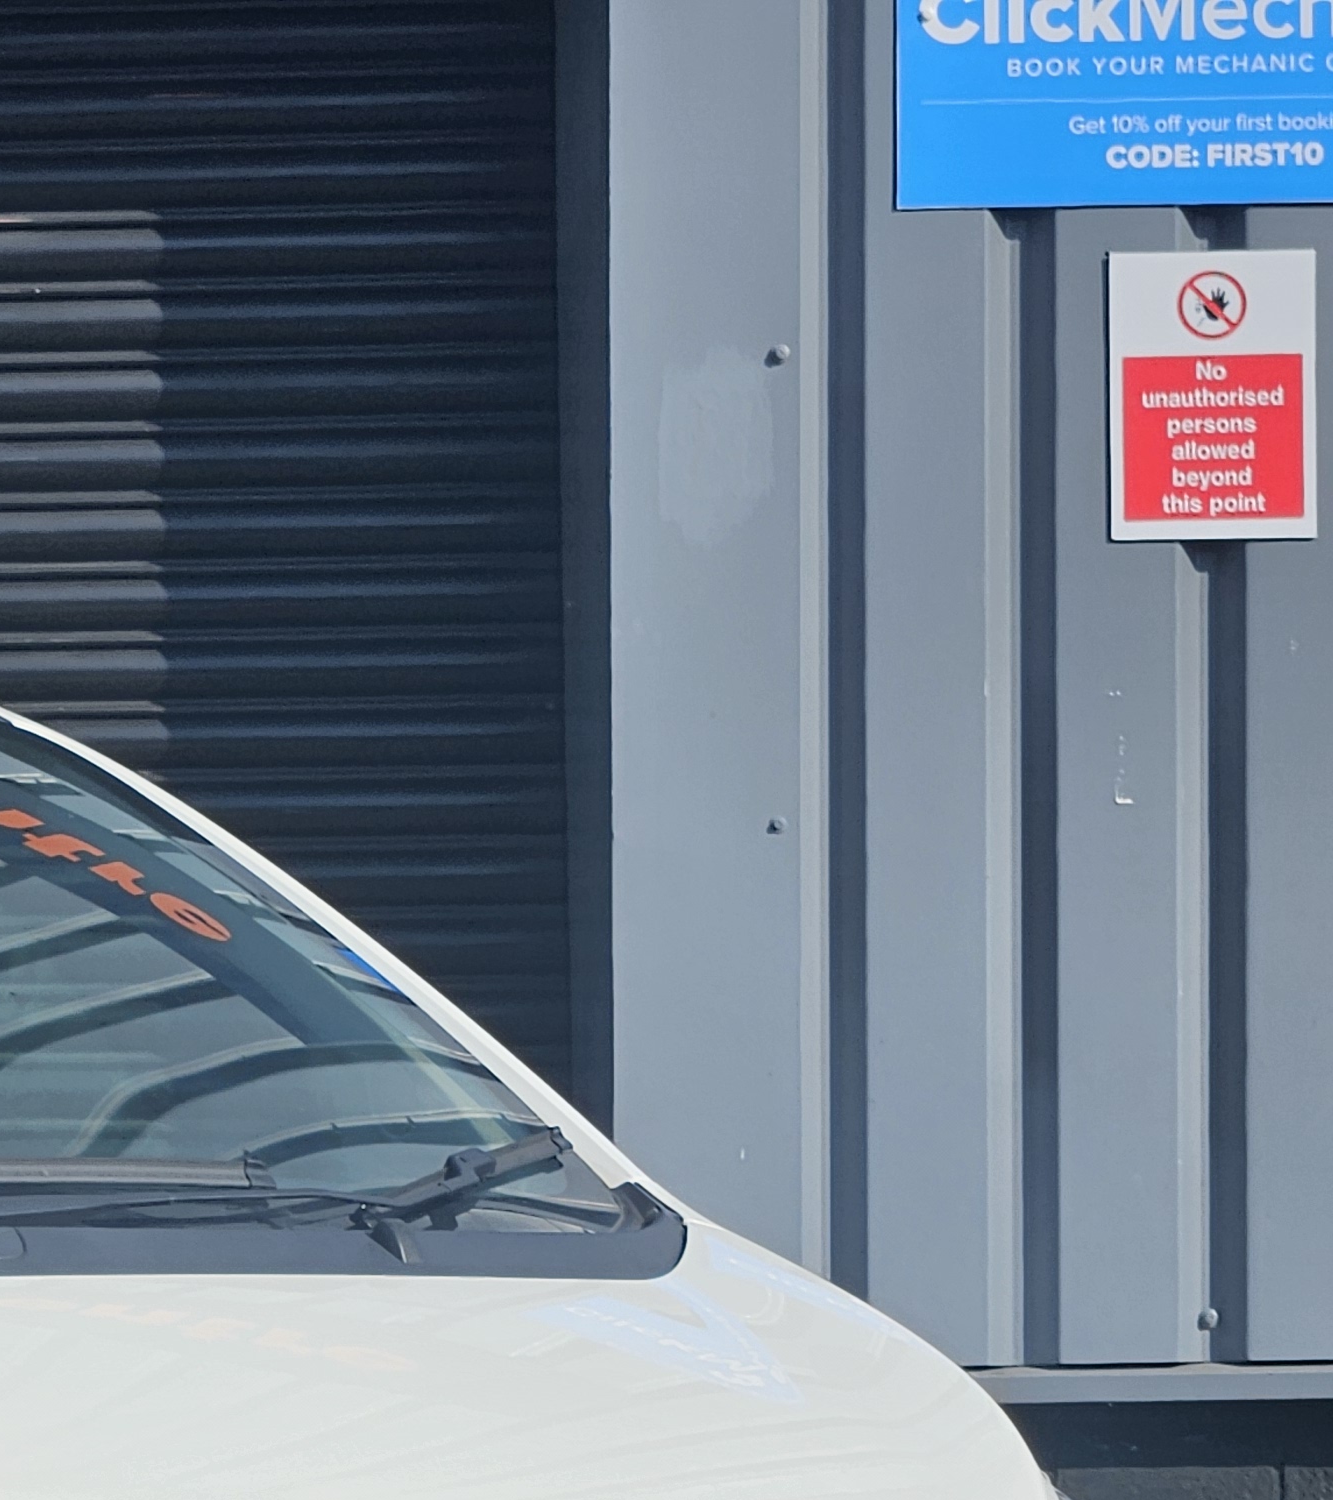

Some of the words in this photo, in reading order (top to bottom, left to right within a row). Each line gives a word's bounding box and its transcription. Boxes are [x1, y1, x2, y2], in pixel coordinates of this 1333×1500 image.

[1007, 57, 1082, 78] BOOK
[1093, 55, 1165, 77] YOUR
[1175, 53, 1315, 74] MECHANIC
[1069, 115, 1107, 135] Get
[1112, 114, 1150, 135] 10%
[1155, 113, 1182, 133] off
[1186, 116, 1230, 138] your
[1236, 112, 1274, 132] first
[1106, 143, 1200, 170] CODE:
[1207, 142, 1325, 169] FIRST10
[1195, 360, 1227, 381] No
[1141, 384, 1286, 409] unauthorised
[1167, 416, 1258, 439] persons
[1171, 439, 1256, 461] allowed
[1172, 465, 1253, 491] beyond
[1162, 492, 1203, 514] this
[1209, 491, 1267, 517] point
